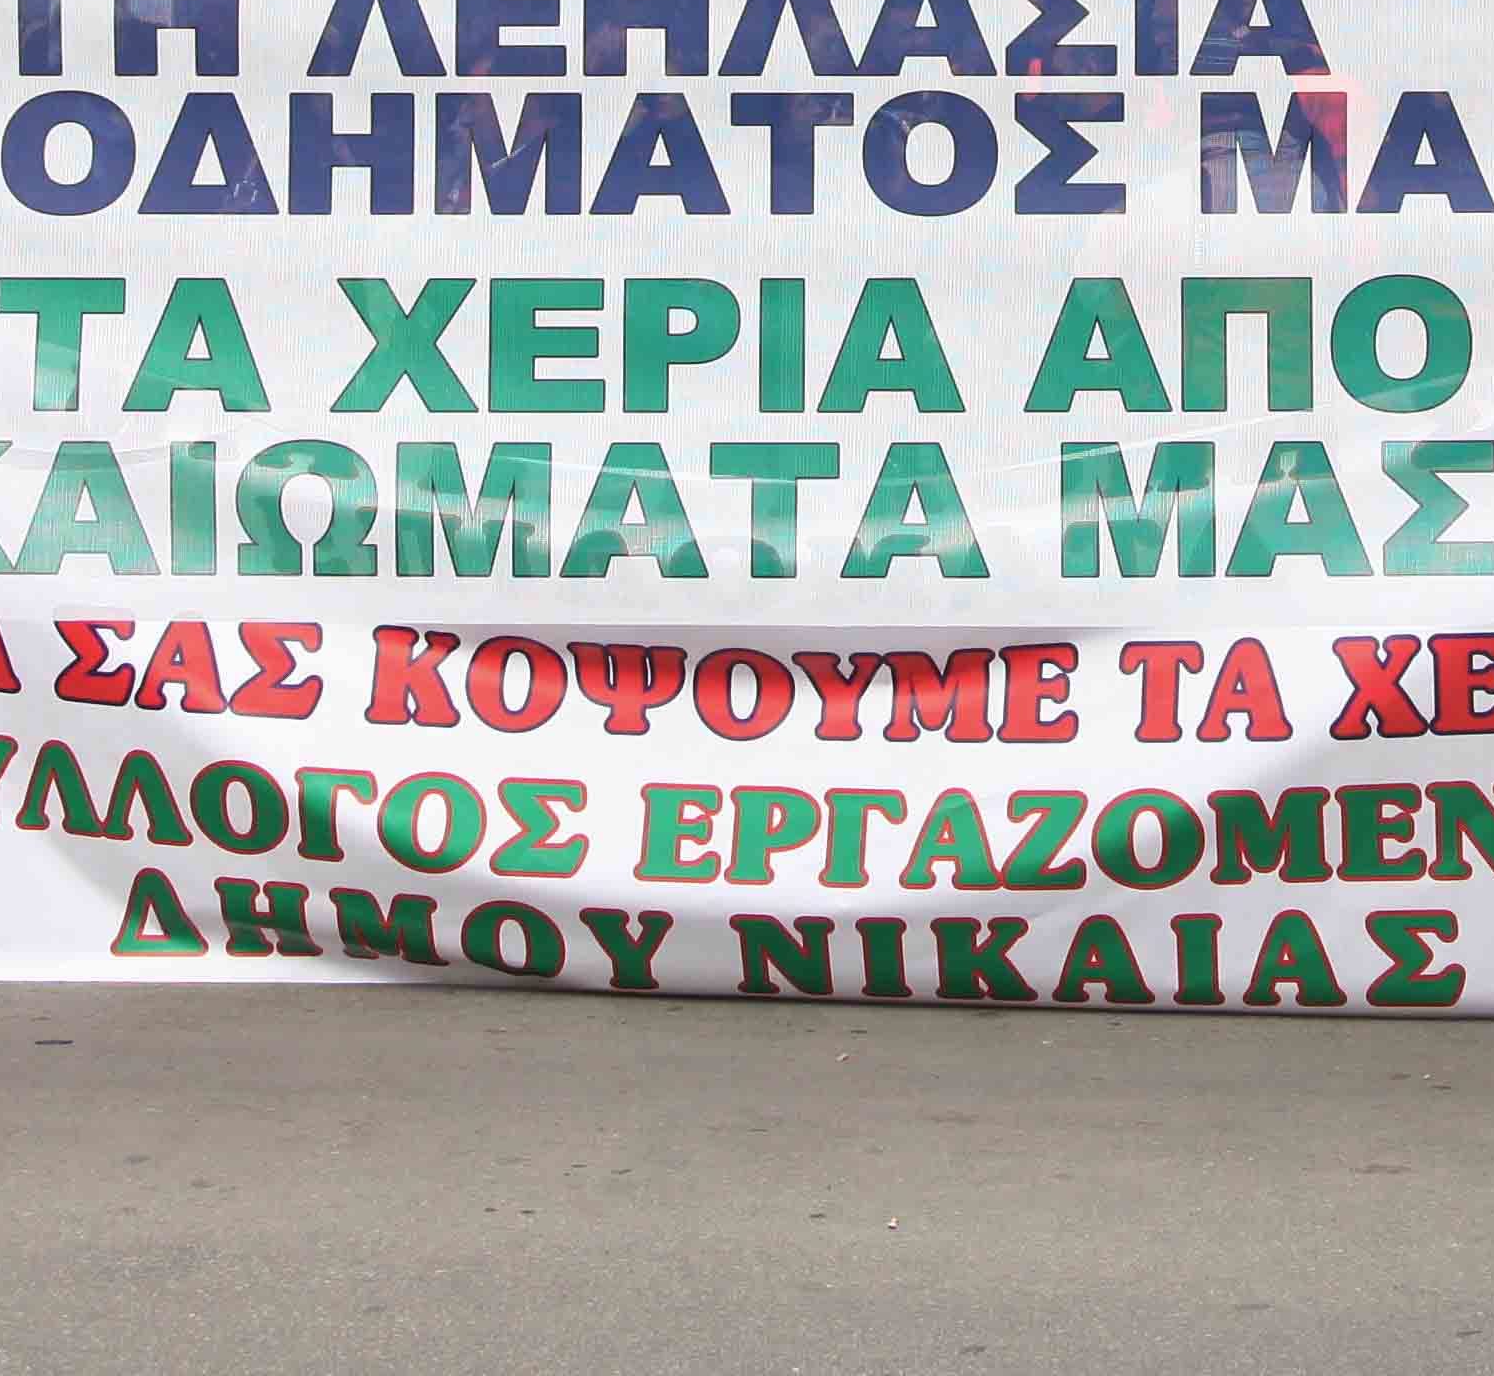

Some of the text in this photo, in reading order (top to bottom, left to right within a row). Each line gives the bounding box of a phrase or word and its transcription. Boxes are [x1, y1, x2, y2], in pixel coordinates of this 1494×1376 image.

[330, 277, 966, 413] ΧΕΡΙΑ
[1024, 273, 1474, 413] ΑΠΟ
[54, 616, 323, 721] ΣΑΣ
[364, 625, 1079, 742] ΚΟΨΟΥΜΕ
[1121, 636, 1292, 743] ΤΑ
[111, 867, 1466, 1008] ΔΗΜΟΥ ΝΙΚΑΙΑΣ
